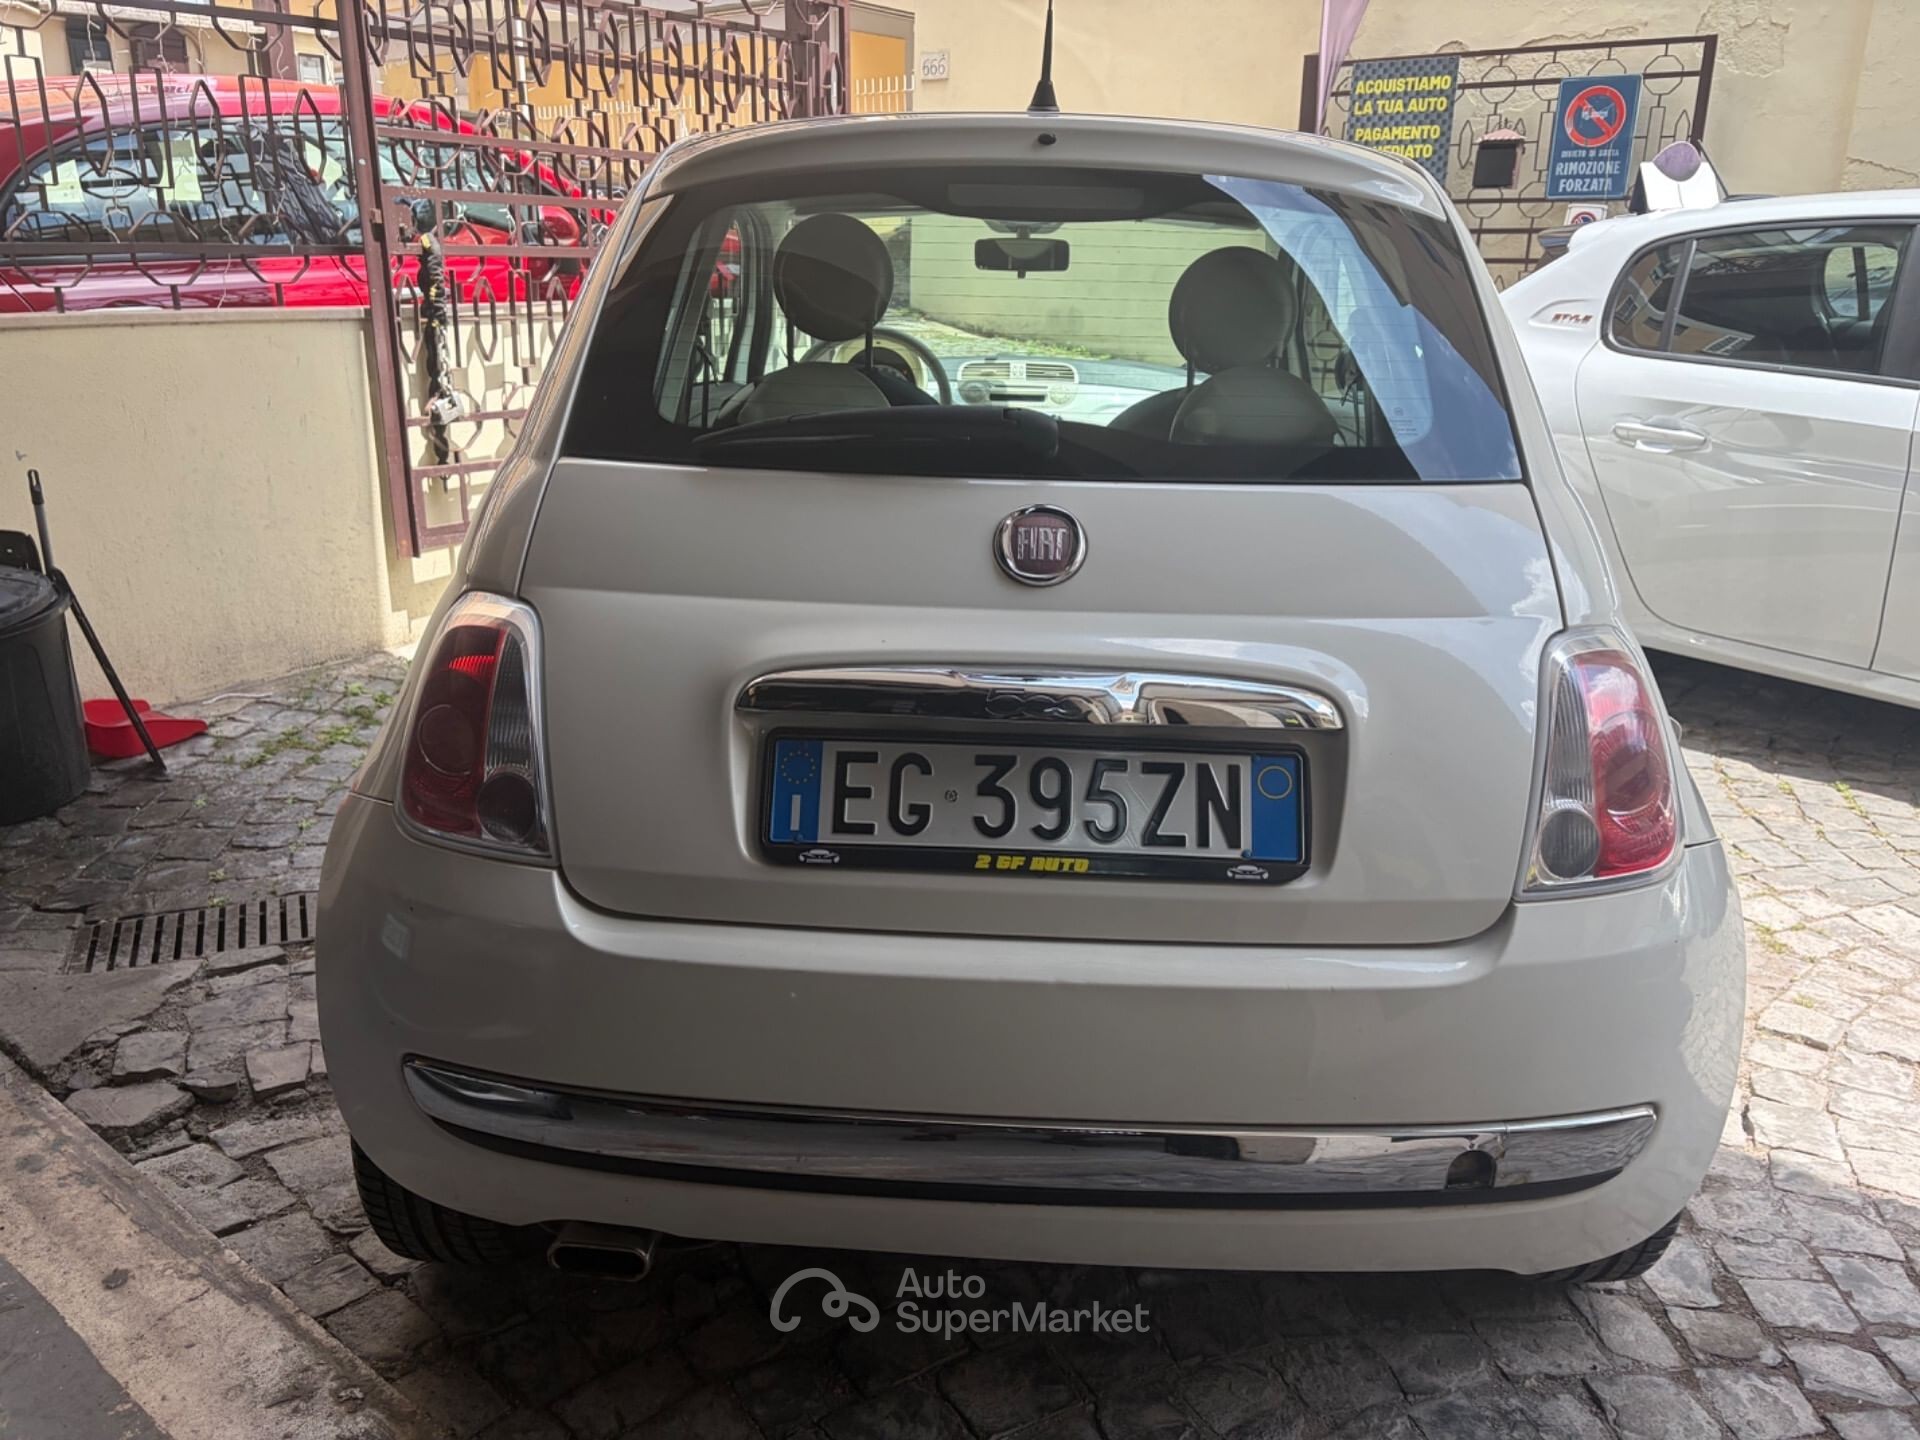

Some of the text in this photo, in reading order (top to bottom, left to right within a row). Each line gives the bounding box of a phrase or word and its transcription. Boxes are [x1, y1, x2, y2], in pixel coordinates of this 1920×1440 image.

[1355, 75, 1452, 95] ACQUISTIAMO
[1354, 96, 1448, 115] LA TUA AUTO
[1354, 125, 1440, 141] PAGAMENTO
[1555, 161, 1621, 176] RIMOZIONE
[1558, 177, 1613, 193] FORZATA
[1017, 527, 1067, 560] FIAT
[831, 751, 1242, 849] EG 395ZN
[974, 854, 992, 870] 2
[1029, 856, 1090, 873] AUTO
